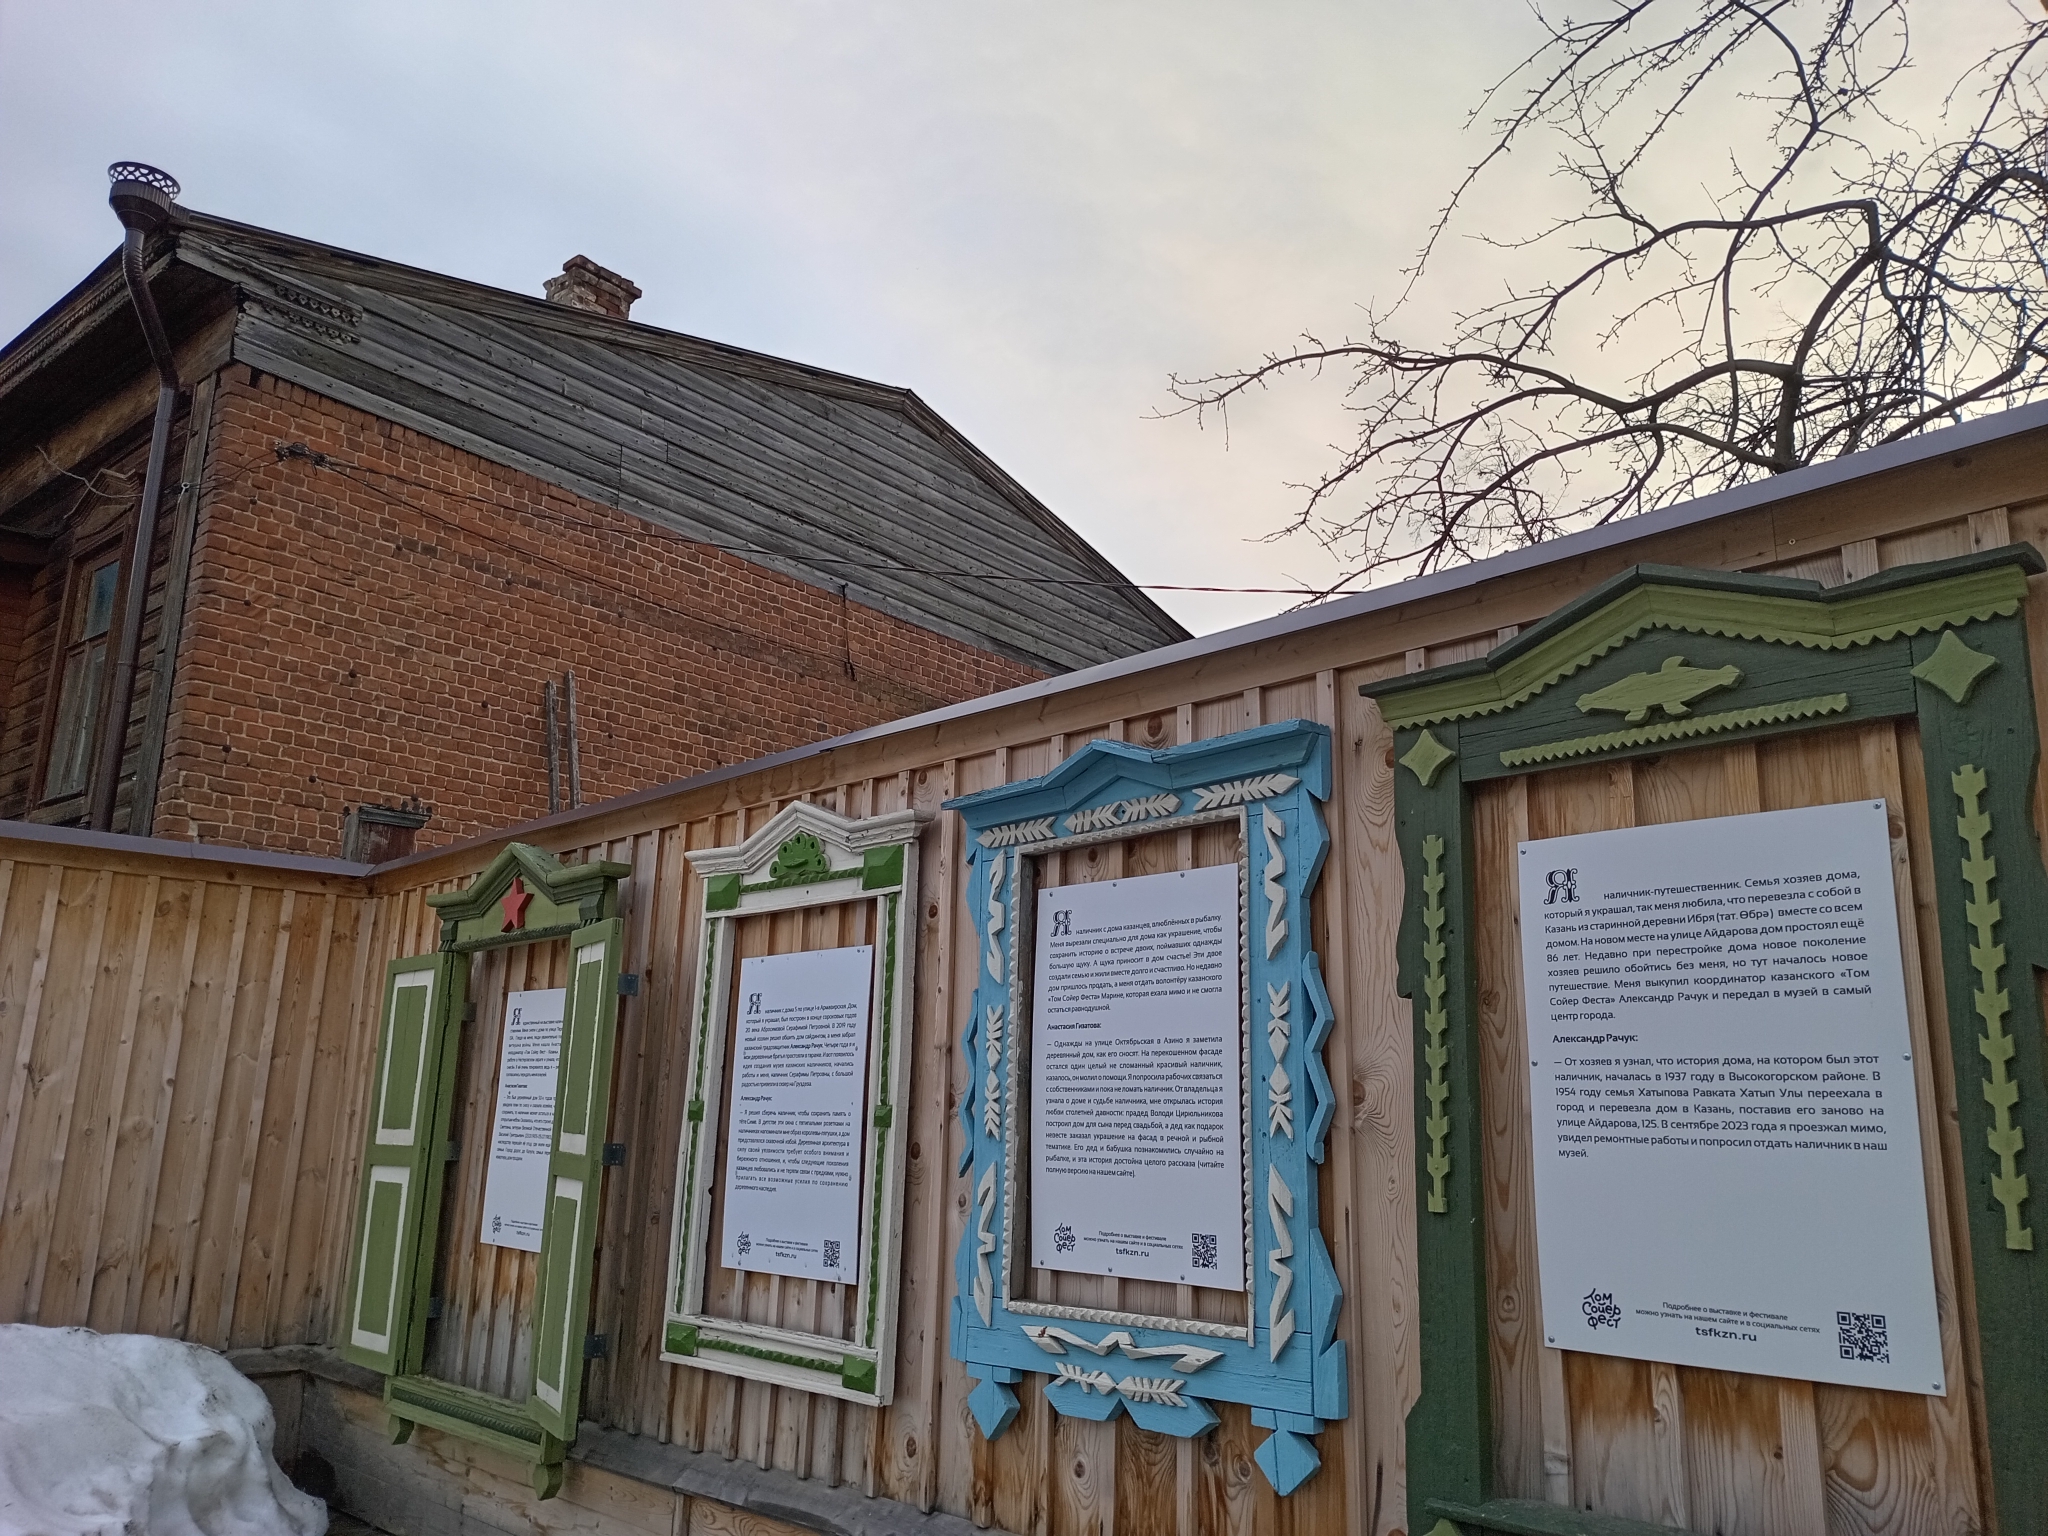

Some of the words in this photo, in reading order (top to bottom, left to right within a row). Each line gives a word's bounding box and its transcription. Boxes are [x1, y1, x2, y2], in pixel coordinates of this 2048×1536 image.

[1543, 868, 1580, 905] Я
[1603, 881, 1741, 899] наличник-путешественник.
[1744, 877, 1779, 887] Семья
[1782, 874, 1822, 884] хозяев
[1825, 871, 1860, 882] дома,
[1544, 908, 1582, 919] который
[1591, 905, 1635, 917] украшал,
[1654, 901, 1680, 910] меня
[1681, 897, 1725, 908] любила,
[1726, 896, 1745, 904] что
[1747, 891, 1805, 904] перевезла
[1807, 890, 1814, 898] с
[1816, 885, 1851, 897] собой
[1050, 909, 1073, 938] Я
[1544, 925, 1576, 933] Казань
[1589, 918, 1640, 930] старинной
[1641, 916, 1685, 928] деревни
[1687, 913, 1714, 924] Ибря
[1716, 912, 1739, 922] (тат.
[1777, 907, 1817, 916] вместе
[1818, 905, 1832, 913] со
[1833, 903, 1862, 912] всем
[1545, 939, 1579, 949] домом.
[1580, 937, 1593, 945] На
[1594, 936, 1625, 944] новом
[1626, 934, 1655, 942] месте
[1669, 931, 1701, 941] улице
[1703, 927, 1758, 938] Айдарова
[1759, 925, 1783, 935] дом
[1784, 921, 1838, 933] простоял
[1840, 918, 1864, 929] ещё
[1548, 982, 1610, 992] путешествие.
[1614, 979, 1640, 988] Меня
[1645, 978, 1689, 987] выкупил
[1693, 974, 1765, 985] координатор
[1770, 971, 1834, 981] казанского
[1840, 968, 1869, 977] «Том
[747, 992, 763, 1015] Я
[1549, 997, 1578, 1006] Сойер
[1581, 996, 1615, 1004] Феста»
[1618, 994, 1674, 1003] Александр
[1677, 992, 1708, 1002] Рачук
[1722, 990, 1769, 1000] передал
[1783, 986, 1817, 998] музей
[1833, 984, 1871, 995] самый
[1550, 1013, 1578, 1022] центр
[1579, 1011, 1615, 1021] города.
[1552, 1034, 1605, 1044] Александр
[1605, 1033, 1638, 1043] Рачук:
[1564, 1057, 1577, 1065] От
[1622, 1058, 1653, 1067] узнал,
[1676, 1057, 1719, 1066] история
[1721, 1057, 1754, 1066] дома,
[1773, 1056, 1822, 1066] котором
[1825, 1054, 1850, 1063] был
[1853, 1055, 1878, 1063] этот
[1554, 1074, 1602, 1082] наличник,
[1664, 1071, 1686, 1080] 1937
[1690, 1073, 1714, 1082] году
[1728, 1071, 1817, 1082] Высокогорском
[1822, 1071, 1868, 1082] районе.
[1872, 1070, 1880, 1080] В
[1556, 1119, 1585, 1128] улице
[1587, 1118, 1639, 1129] Айдарова,
[1641, 1118, 1658, 1128] 125.
[1660, 1119, 1668, 1128] В
[1670, 1119, 1719, 1131] сентябре
[1721, 1120, 1748, 1130] 2023
[1751, 1123, 1777, 1132] года
[1779, 1123, 1786, 1131] я
[1788, 1123, 1847, 1133] проезжал
[1850, 1125, 1886, 1134] мимо,
[1557, 1134, 1592, 1143] увидел
[1593, 1135, 1649, 1144] ремонтные
[1650, 1135, 1689, 1145] работы
[1698, 1138, 1751, 1148] попросил
[1753, 1139, 1792, 1149] отдать
[1794, 1141, 1852, 1149] наличник
[1862, 1142, 1887, 1150] наш
[1558, 1148, 1589, 1158] музей.
[1115, 1247, 1149, 1257] tsfkzn.ru
[1583, 1288, 1612, 1305] Том
[1582, 1301, 1621, 1318] Сойер
[1662, 1301, 1701, 1312] Подробнее
[1708, 1307, 1741, 1316] выставке
[1748, 1311, 1788, 1320] фестивале
[1659, 1311, 1682, 1319] узнать
[1718, 1317, 1738, 1325] сайте
[1751, 1321, 1797, 1330] социальных
[1695, 1326, 1756, 1341] tsfkzn.ru
